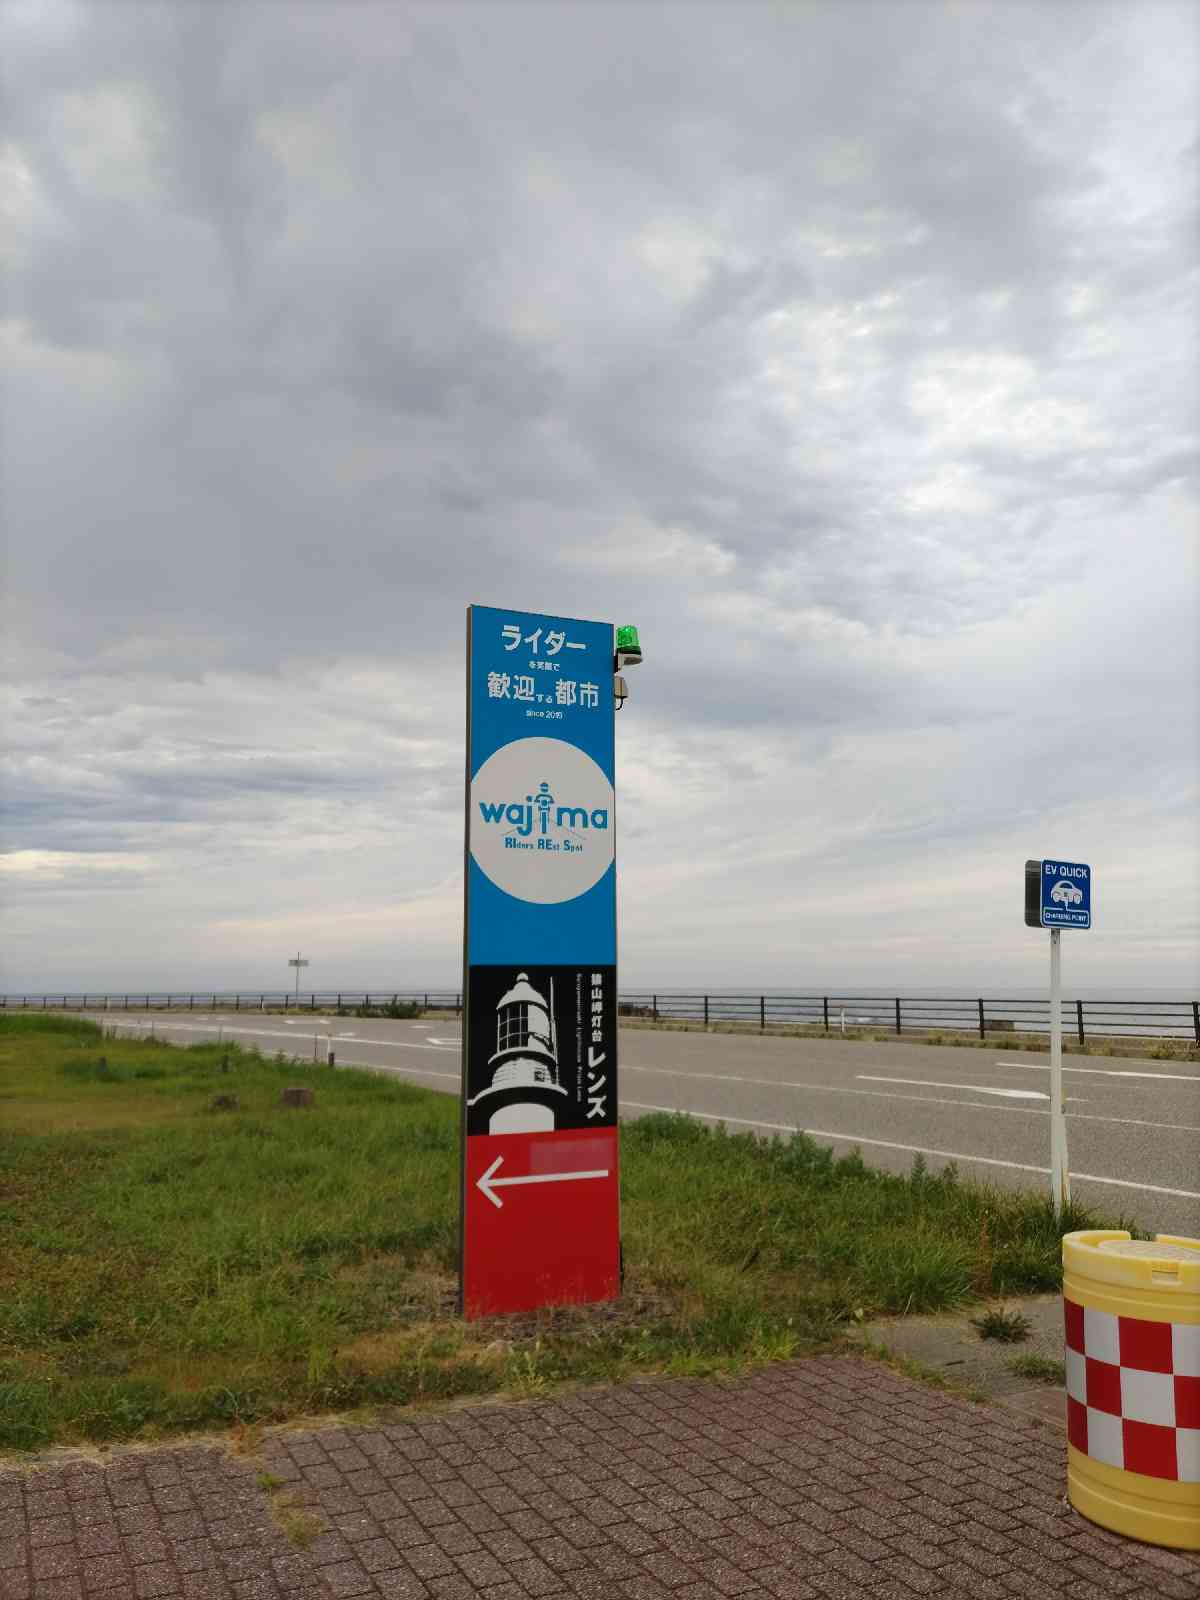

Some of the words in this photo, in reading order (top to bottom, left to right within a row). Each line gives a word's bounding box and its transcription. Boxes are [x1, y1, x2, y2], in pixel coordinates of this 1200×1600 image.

[501, 624, 587, 656] ライダー
[479, 783, 608, 836] wajima
[1045, 864, 1057, 875] EV
[1060, 866, 1088, 878] QUICK
